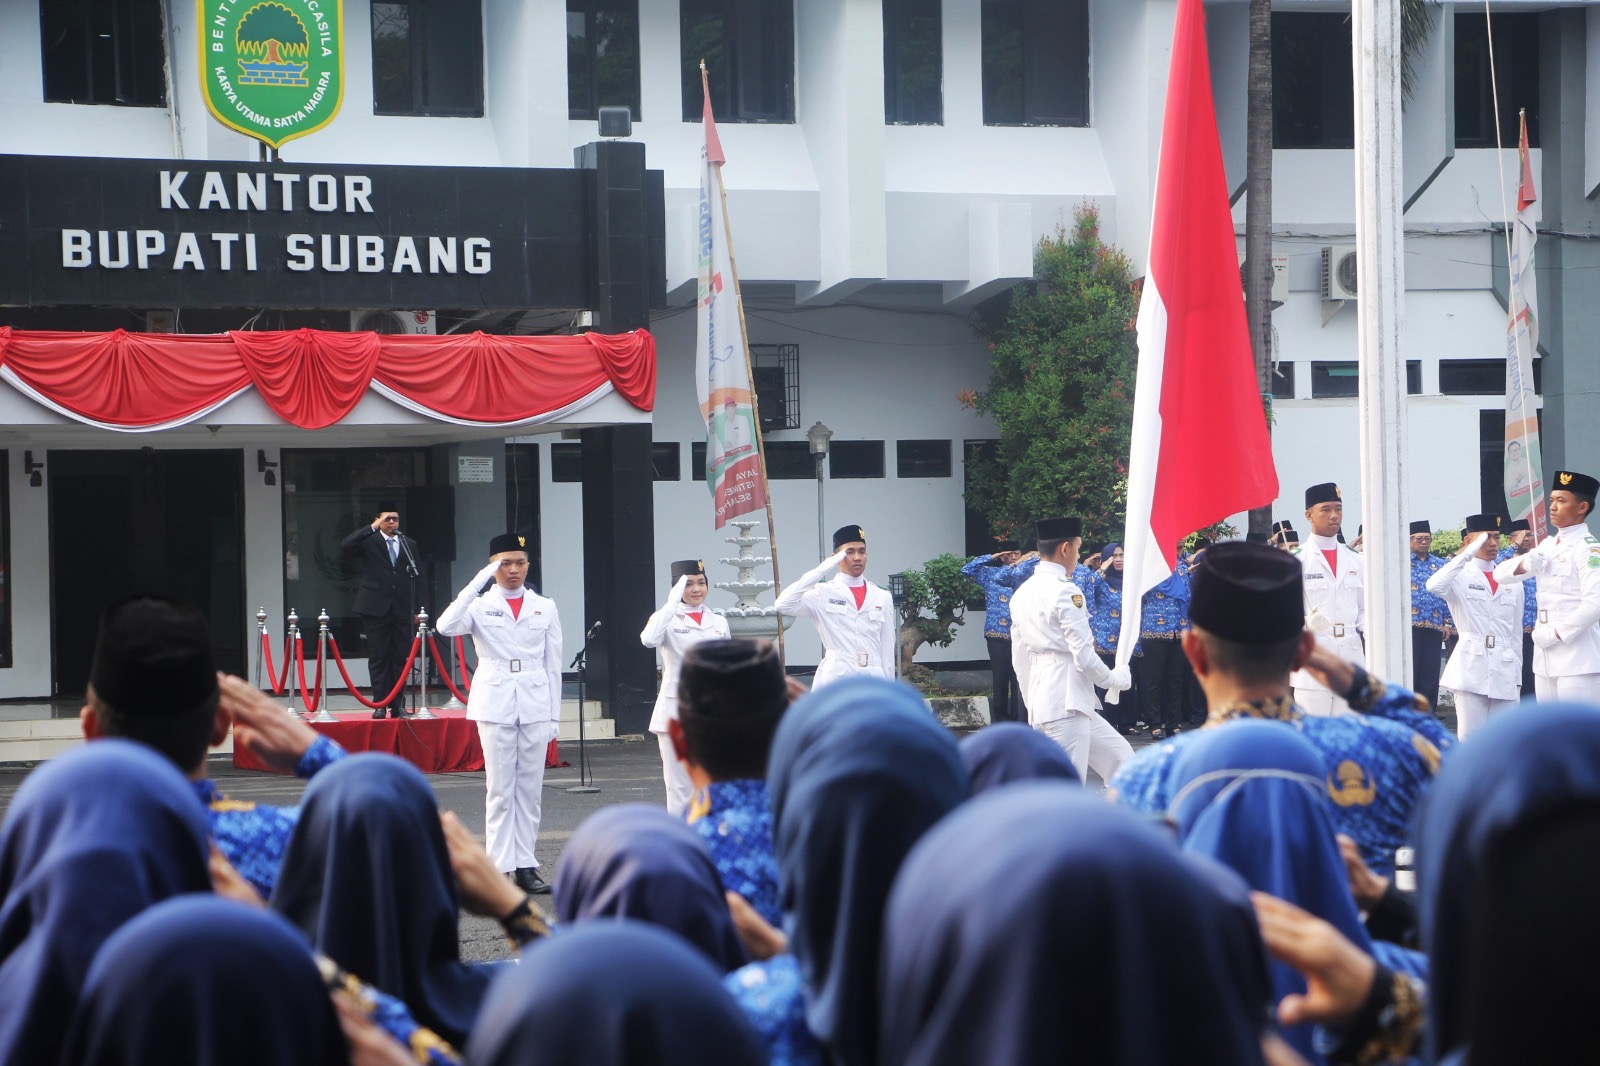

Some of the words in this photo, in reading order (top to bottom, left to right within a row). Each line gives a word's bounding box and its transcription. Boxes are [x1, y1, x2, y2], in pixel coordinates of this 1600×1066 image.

[303, 0, 333, 57] CASILA
[214, 66, 238, 104] KARYA
[235, 101, 271, 127] UTAMA
[273, 110, 307, 128] SATYA
[303, 71, 331, 114] NAGARA
[159, 170, 375, 213] KANTOR
[61, 228, 258, 271] BUPATI
[286, 233, 492, 275] SUBANG
[415, 326, 428, 334] LG
